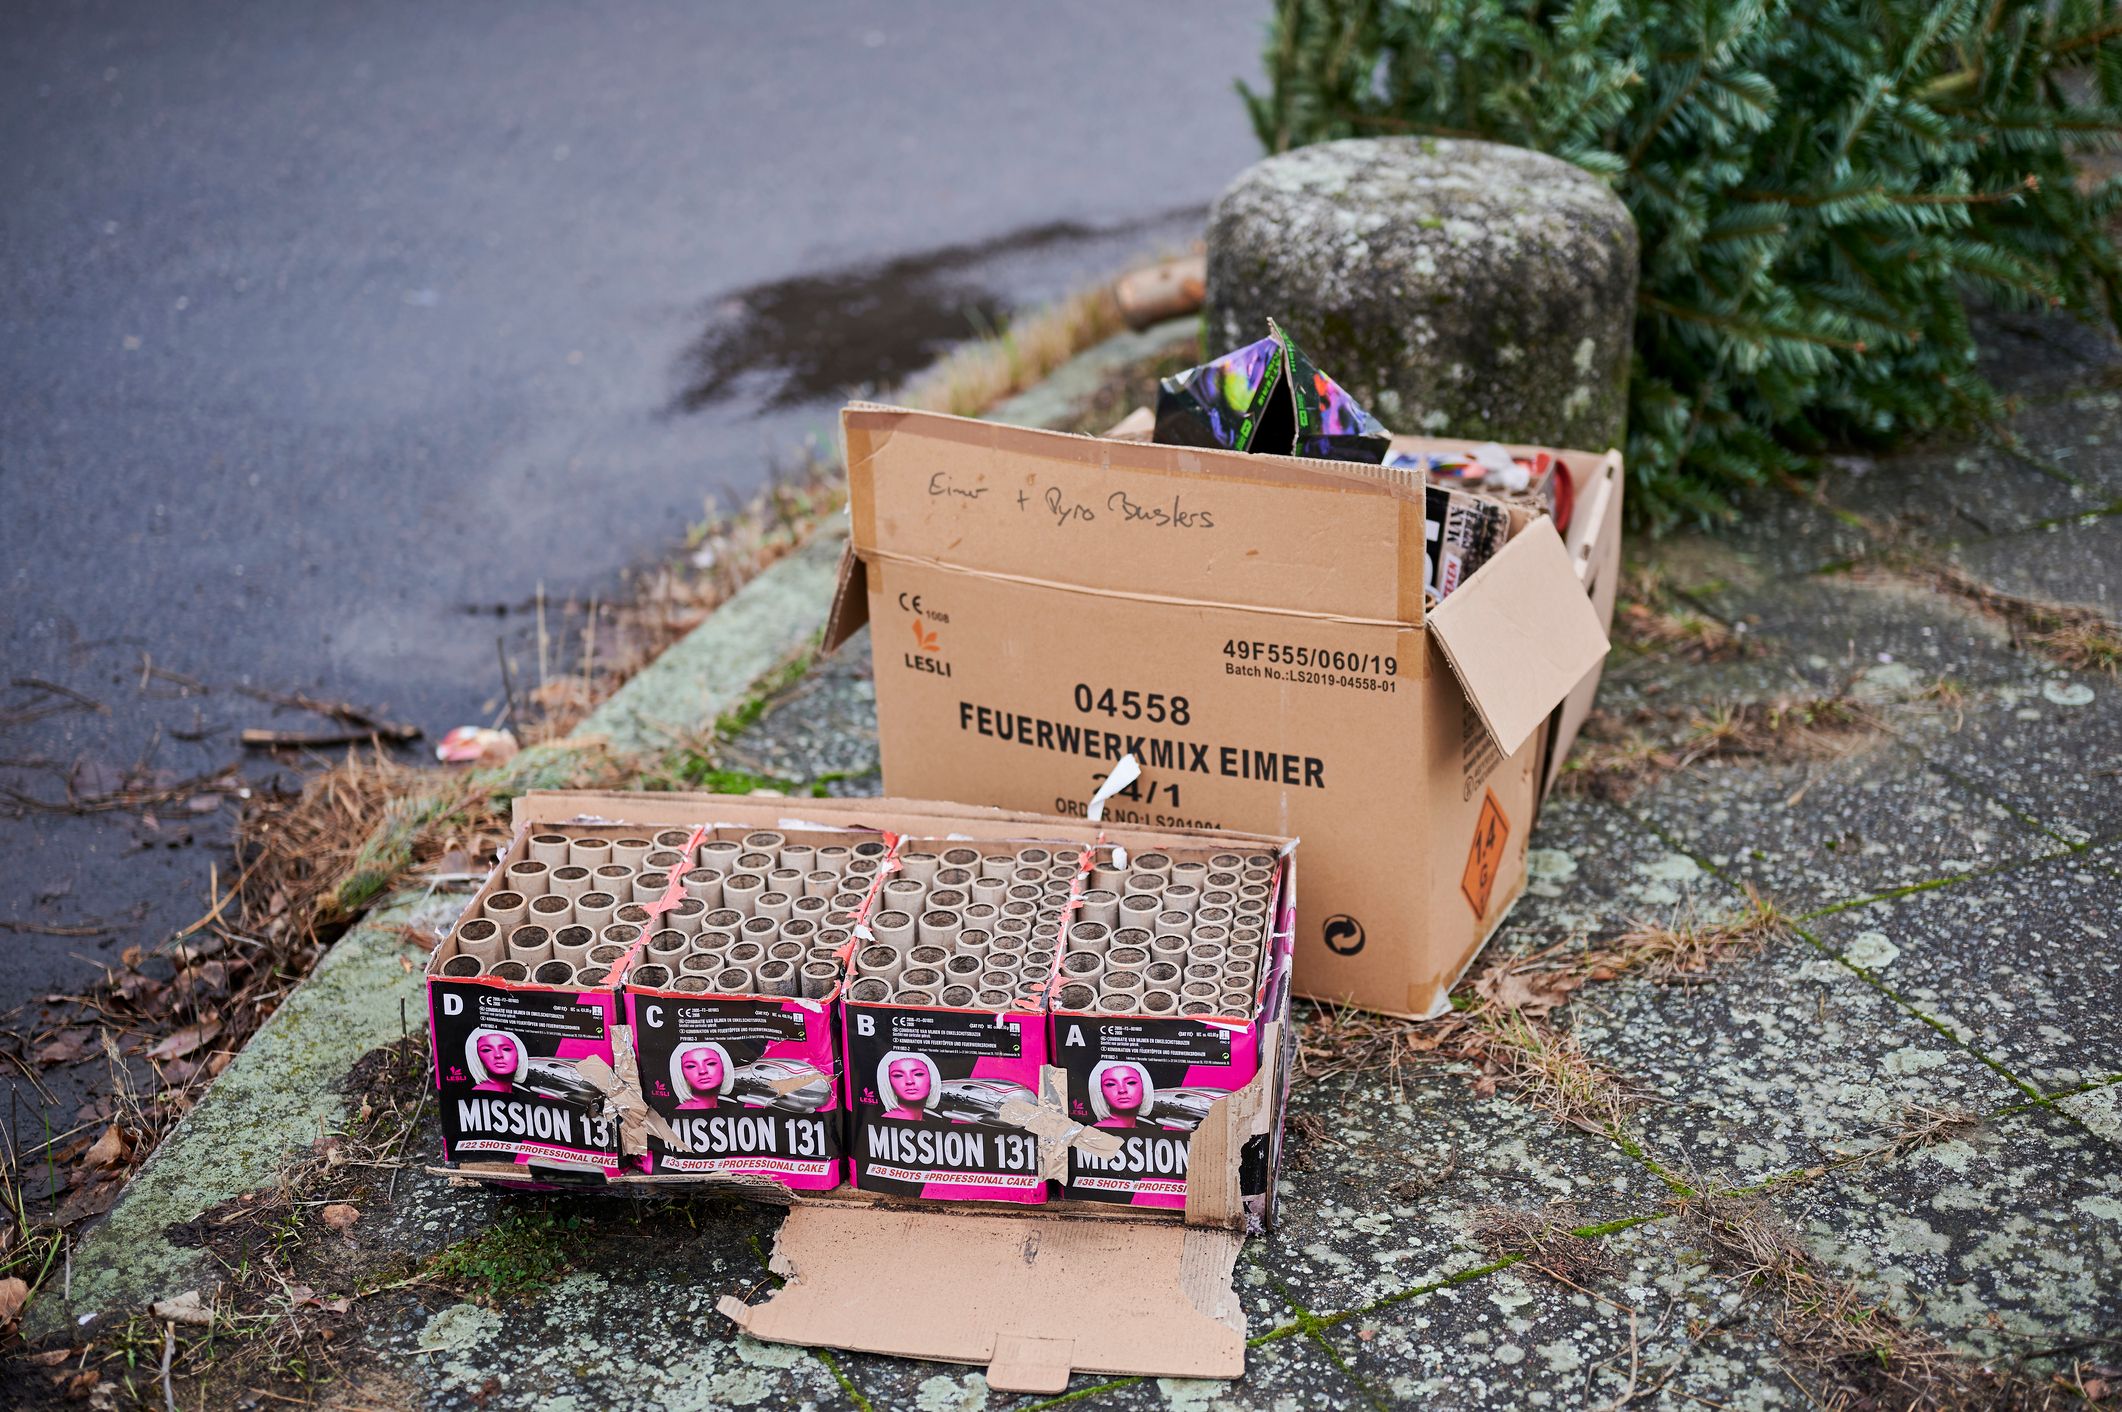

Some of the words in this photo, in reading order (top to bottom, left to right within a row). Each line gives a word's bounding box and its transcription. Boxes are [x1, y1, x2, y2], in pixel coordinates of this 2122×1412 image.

[1045, 487, 1095, 526] Pyro
[904, 652, 951, 678] LESLI
[1223, 639, 1397, 676] 49F555/060/19
[1225, 663, 1261, 678] Batch
[1074, 683, 1191, 726] 04558
[959, 701, 1210, 774] FEUERWERKMIX
[1220, 746, 1325, 789] EIMER
[1055, 797, 1111, 822] ORDR
[443, 993, 463, 1016] D
[645, 1005, 664, 1028] C
[857, 1014, 876, 1037] B
[1065, 1024, 1086, 1047] A
[458, 1098, 572, 1143] MISSION
[785, 1118, 826, 1156] 131
[867, 1124, 985, 1168] MISSION
[994, 1134, 1036, 1170] 131
[460, 1141, 478, 1149] #22
[479, 1141, 512, 1150] SHOTS
[514, 1143, 588, 1163] #PROFESSIONAL
[591, 1156, 617, 1166] CAKE
[681, 1160, 715, 1169] SHOTS
[717, 1158, 794, 1171] #PROFESSIONAL
[797, 1162, 825, 1173] CAKE
[870, 1166, 887, 1175] #38
[889, 1169, 922, 1180] SHOTS
[924, 1172, 1004, 1185] #PROFESSIONAL
[1006, 1178, 1034, 1187] CAKE
[1077, 1179, 1094, 1187] #38
[1096, 1180, 1131, 1190] SHOTS
[1133, 1182, 1188, 1193] #PROFESSI
